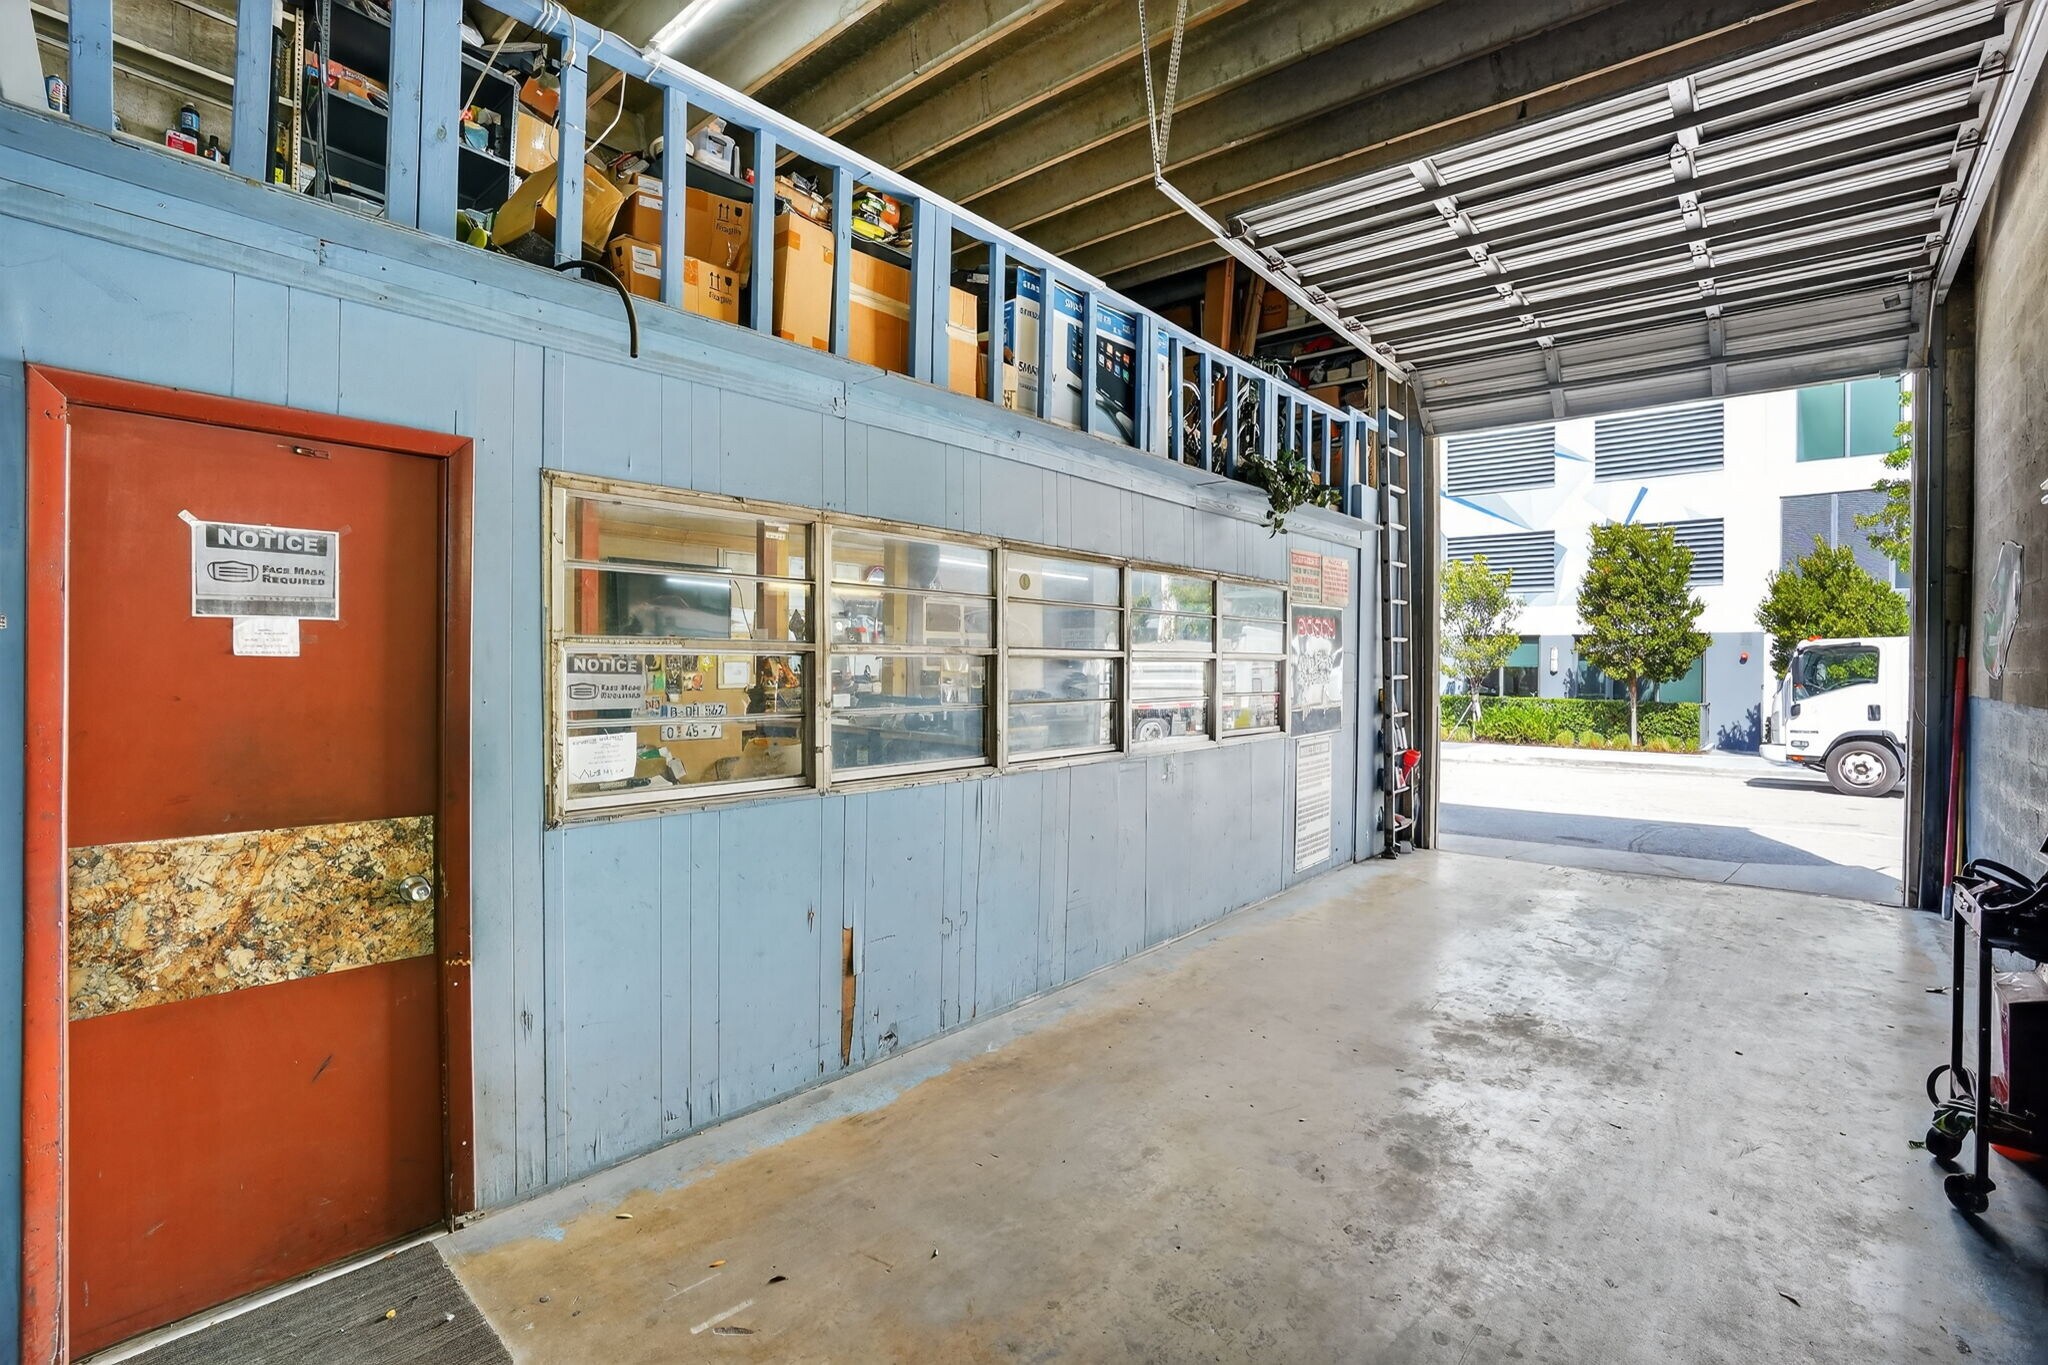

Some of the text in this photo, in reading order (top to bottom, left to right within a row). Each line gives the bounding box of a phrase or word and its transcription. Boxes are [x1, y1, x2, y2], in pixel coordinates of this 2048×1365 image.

[217, 527, 319, 553] NOTICE
[262, 574, 325, 586] REQUIRED
[573, 657, 638, 673] NOTICE
